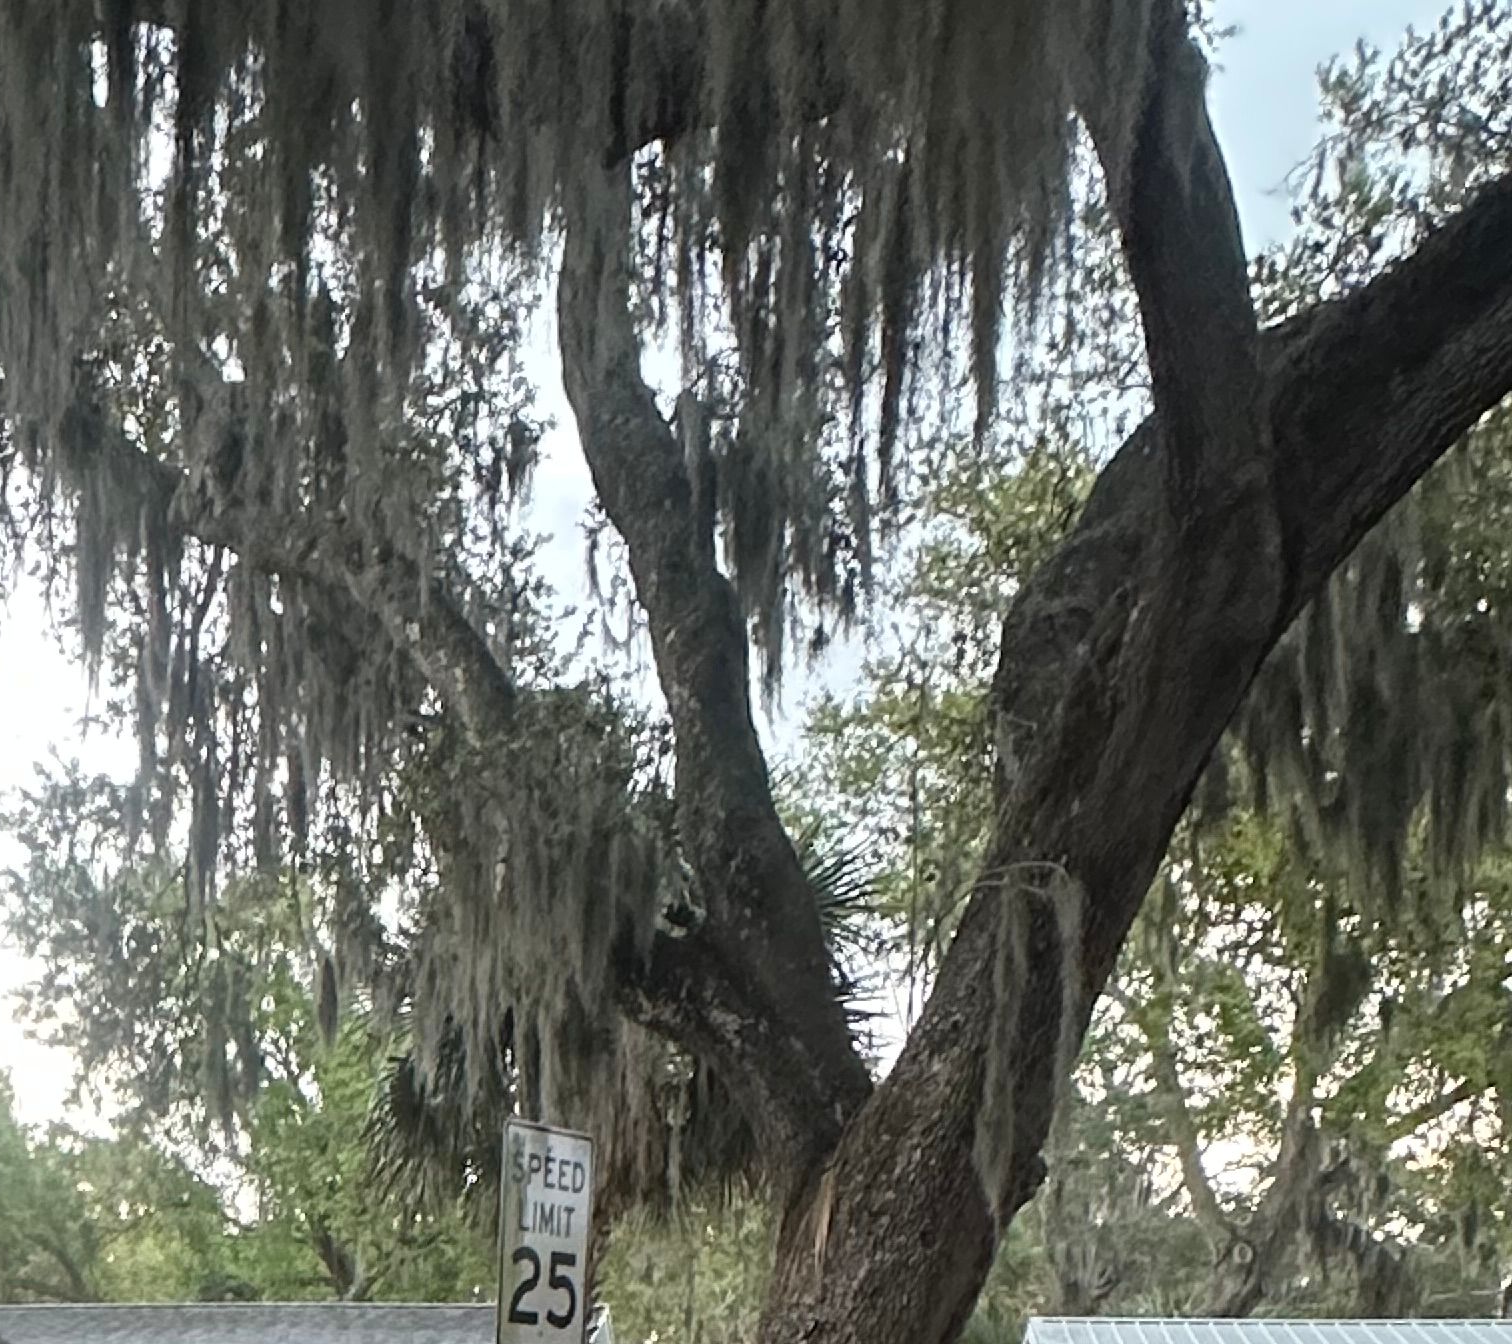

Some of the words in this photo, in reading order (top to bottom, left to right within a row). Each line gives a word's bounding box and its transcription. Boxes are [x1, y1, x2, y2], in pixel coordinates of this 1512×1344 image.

[510, 1151, 585, 1195] SPEED
[518, 1205, 576, 1239] LIMIT
[507, 1246, 578, 1329] 25
